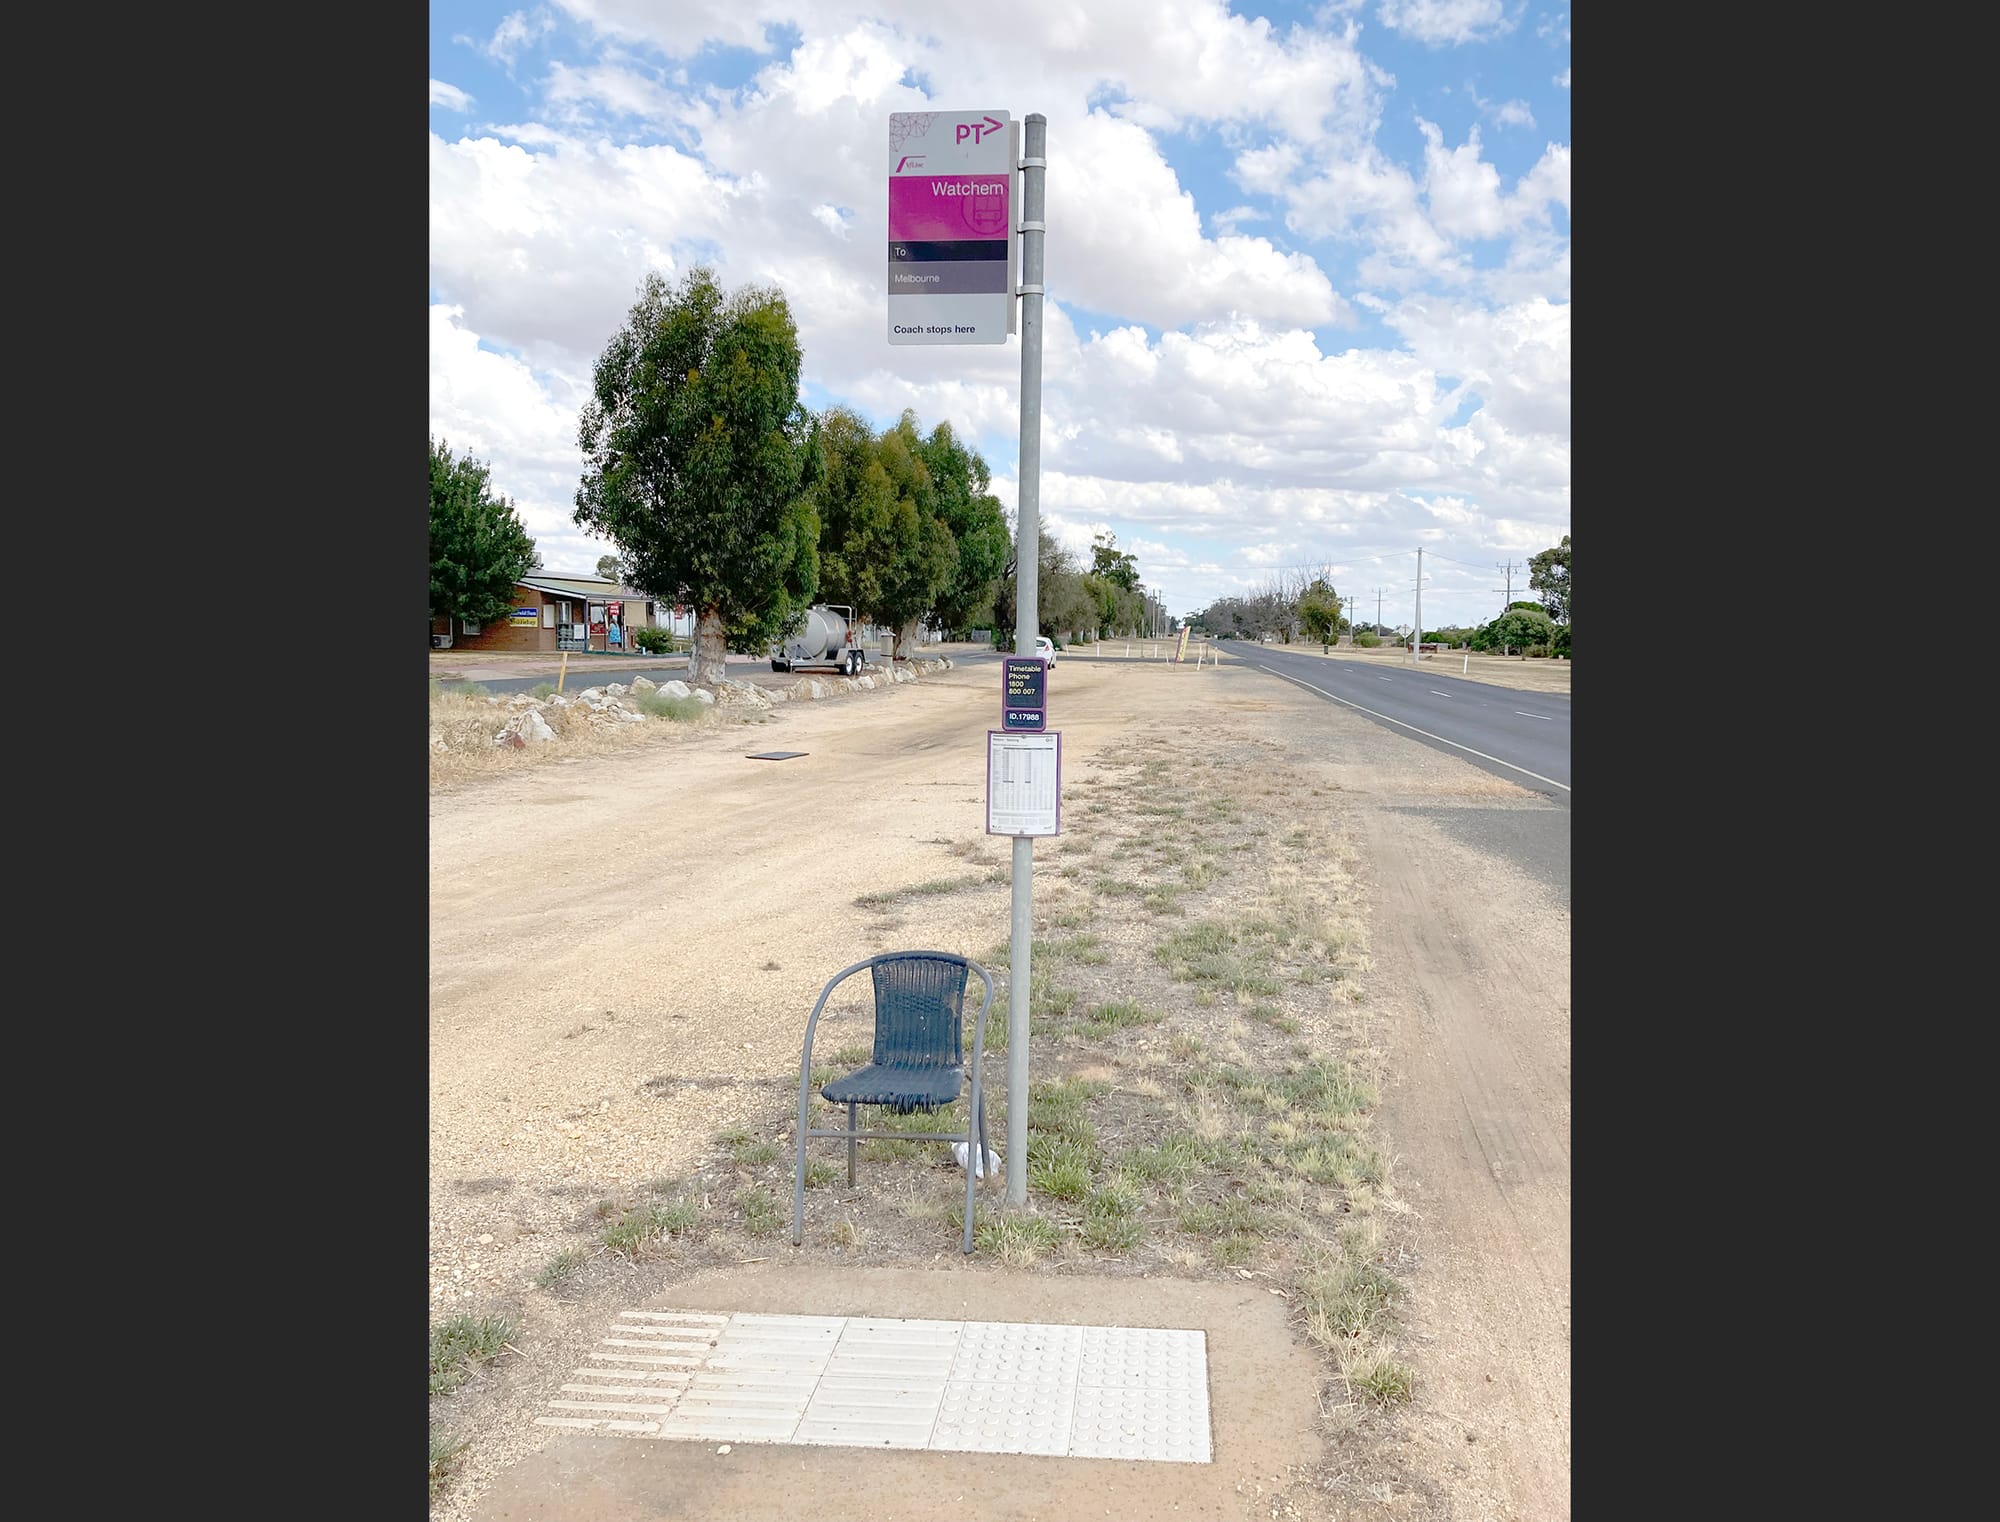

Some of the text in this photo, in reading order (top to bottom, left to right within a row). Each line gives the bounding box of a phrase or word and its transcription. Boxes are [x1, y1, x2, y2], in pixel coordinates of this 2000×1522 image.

[931, 180, 1004, 196] Watchem
[894, 247, 907, 256] To
[894, 274, 940, 283] Melbourne
[893, 325, 976, 335] Coach stops here
[1008, 665, 1042, 673] Timetable
